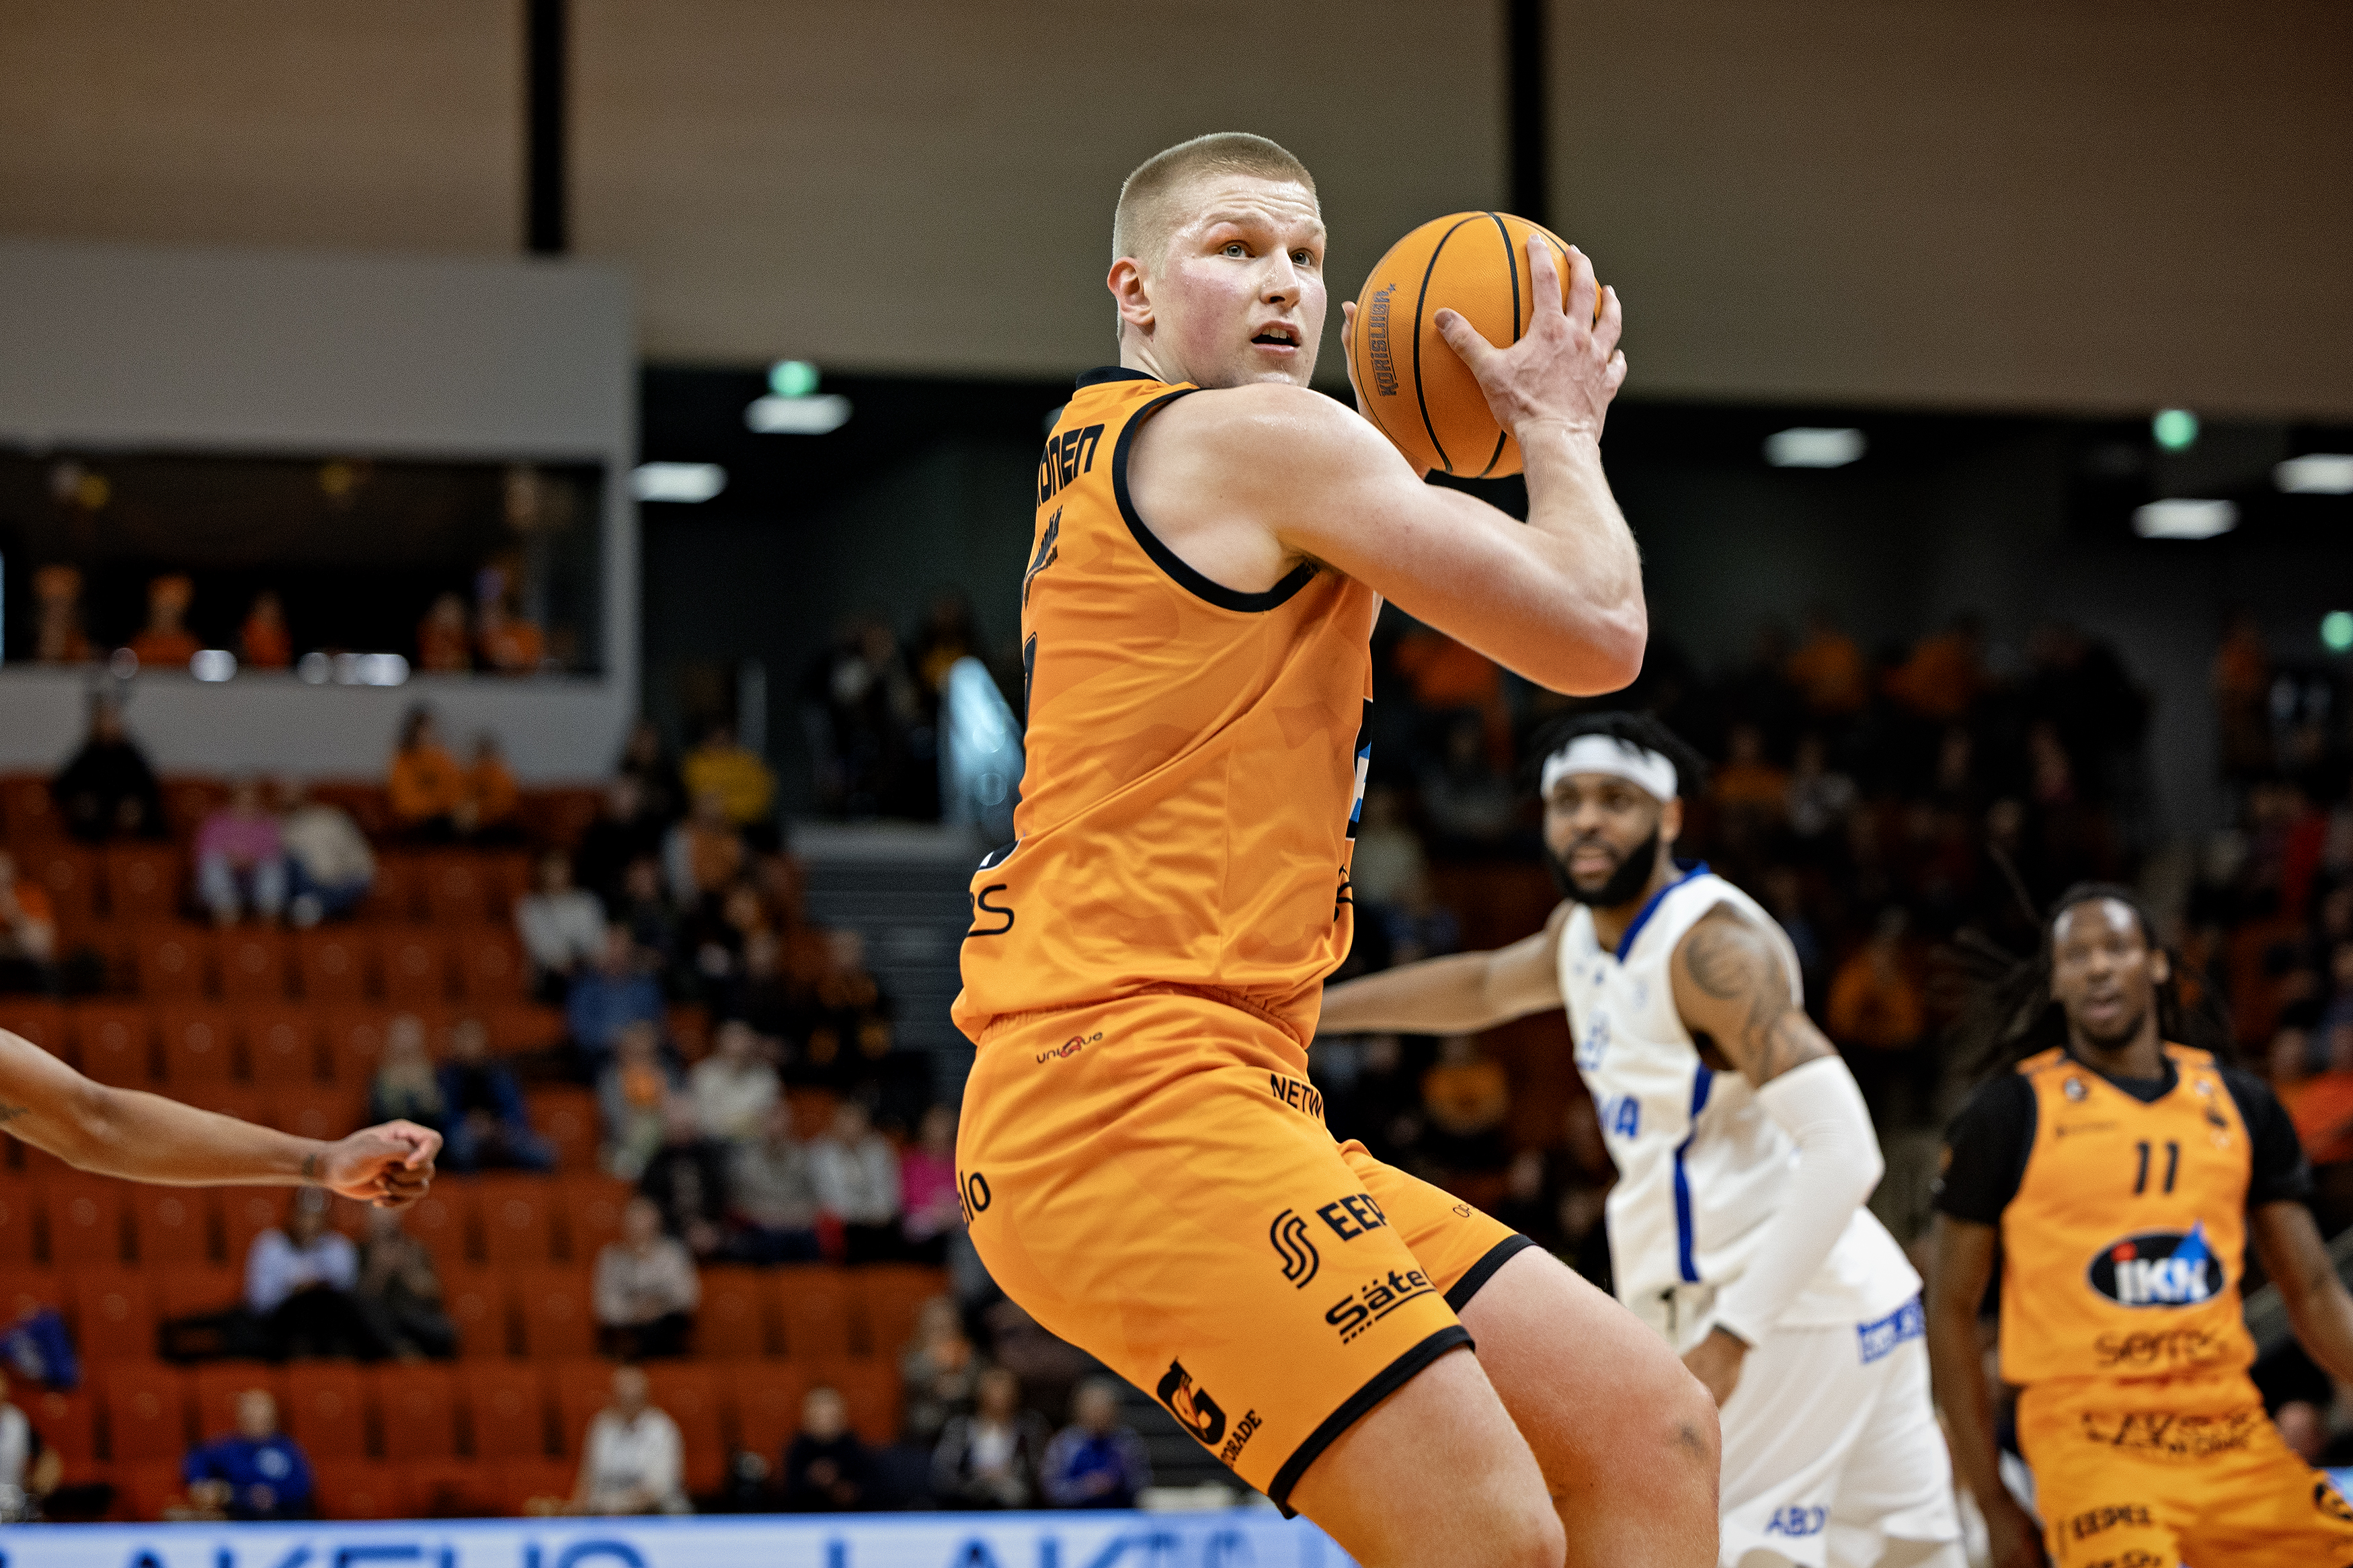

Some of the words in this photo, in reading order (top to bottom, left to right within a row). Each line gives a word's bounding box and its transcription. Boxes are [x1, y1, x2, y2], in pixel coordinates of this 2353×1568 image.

[1037, 423, 1105, 509] ONEN
[2135, 1140, 2180, 1196] 11
[1325, 1267, 1432, 1335] Säte
